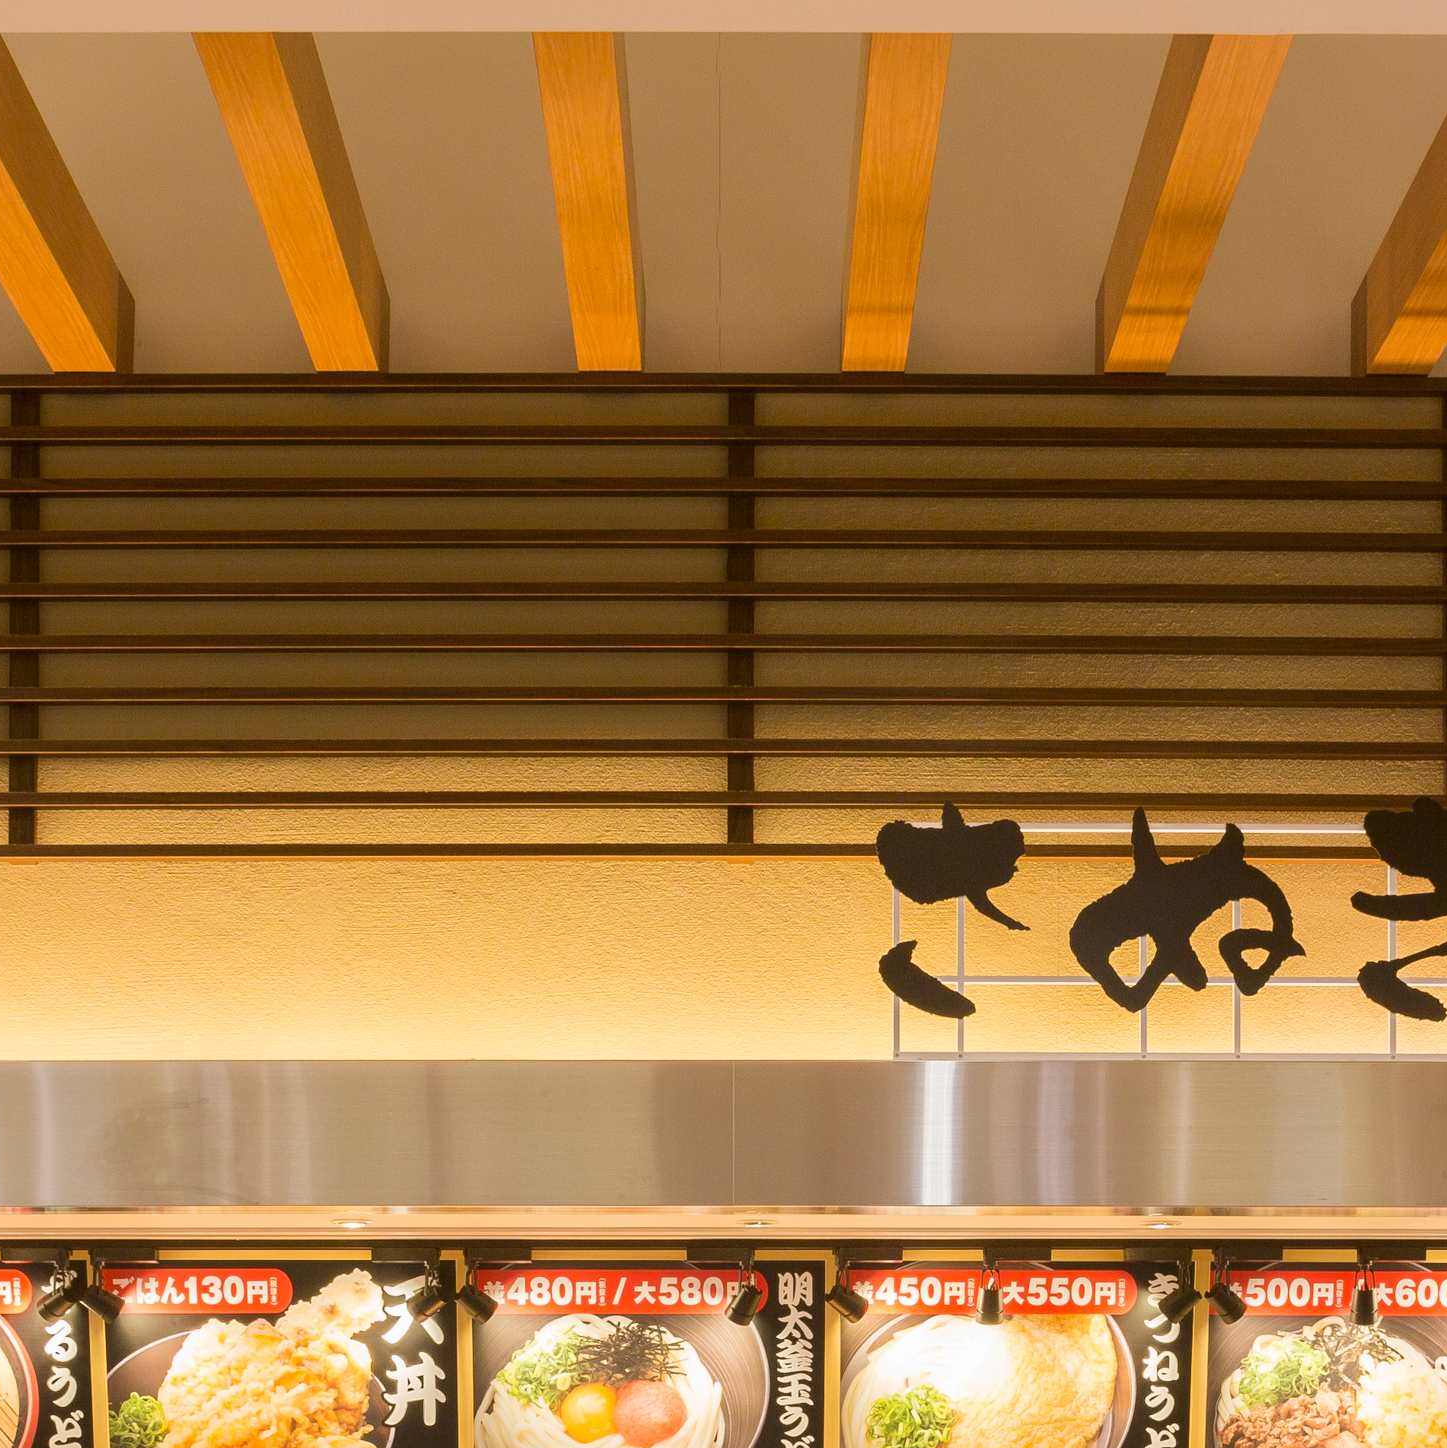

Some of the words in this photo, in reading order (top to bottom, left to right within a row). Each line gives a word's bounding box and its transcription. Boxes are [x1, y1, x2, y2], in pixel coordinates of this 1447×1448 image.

[111, 1275, 270, 1305] ごはん130円
[1003, 1276, 1117, 1307] 大550円
[1230, 1277, 1335, 1308] 500円
[381, 1273, 447, 1426] 天丼
